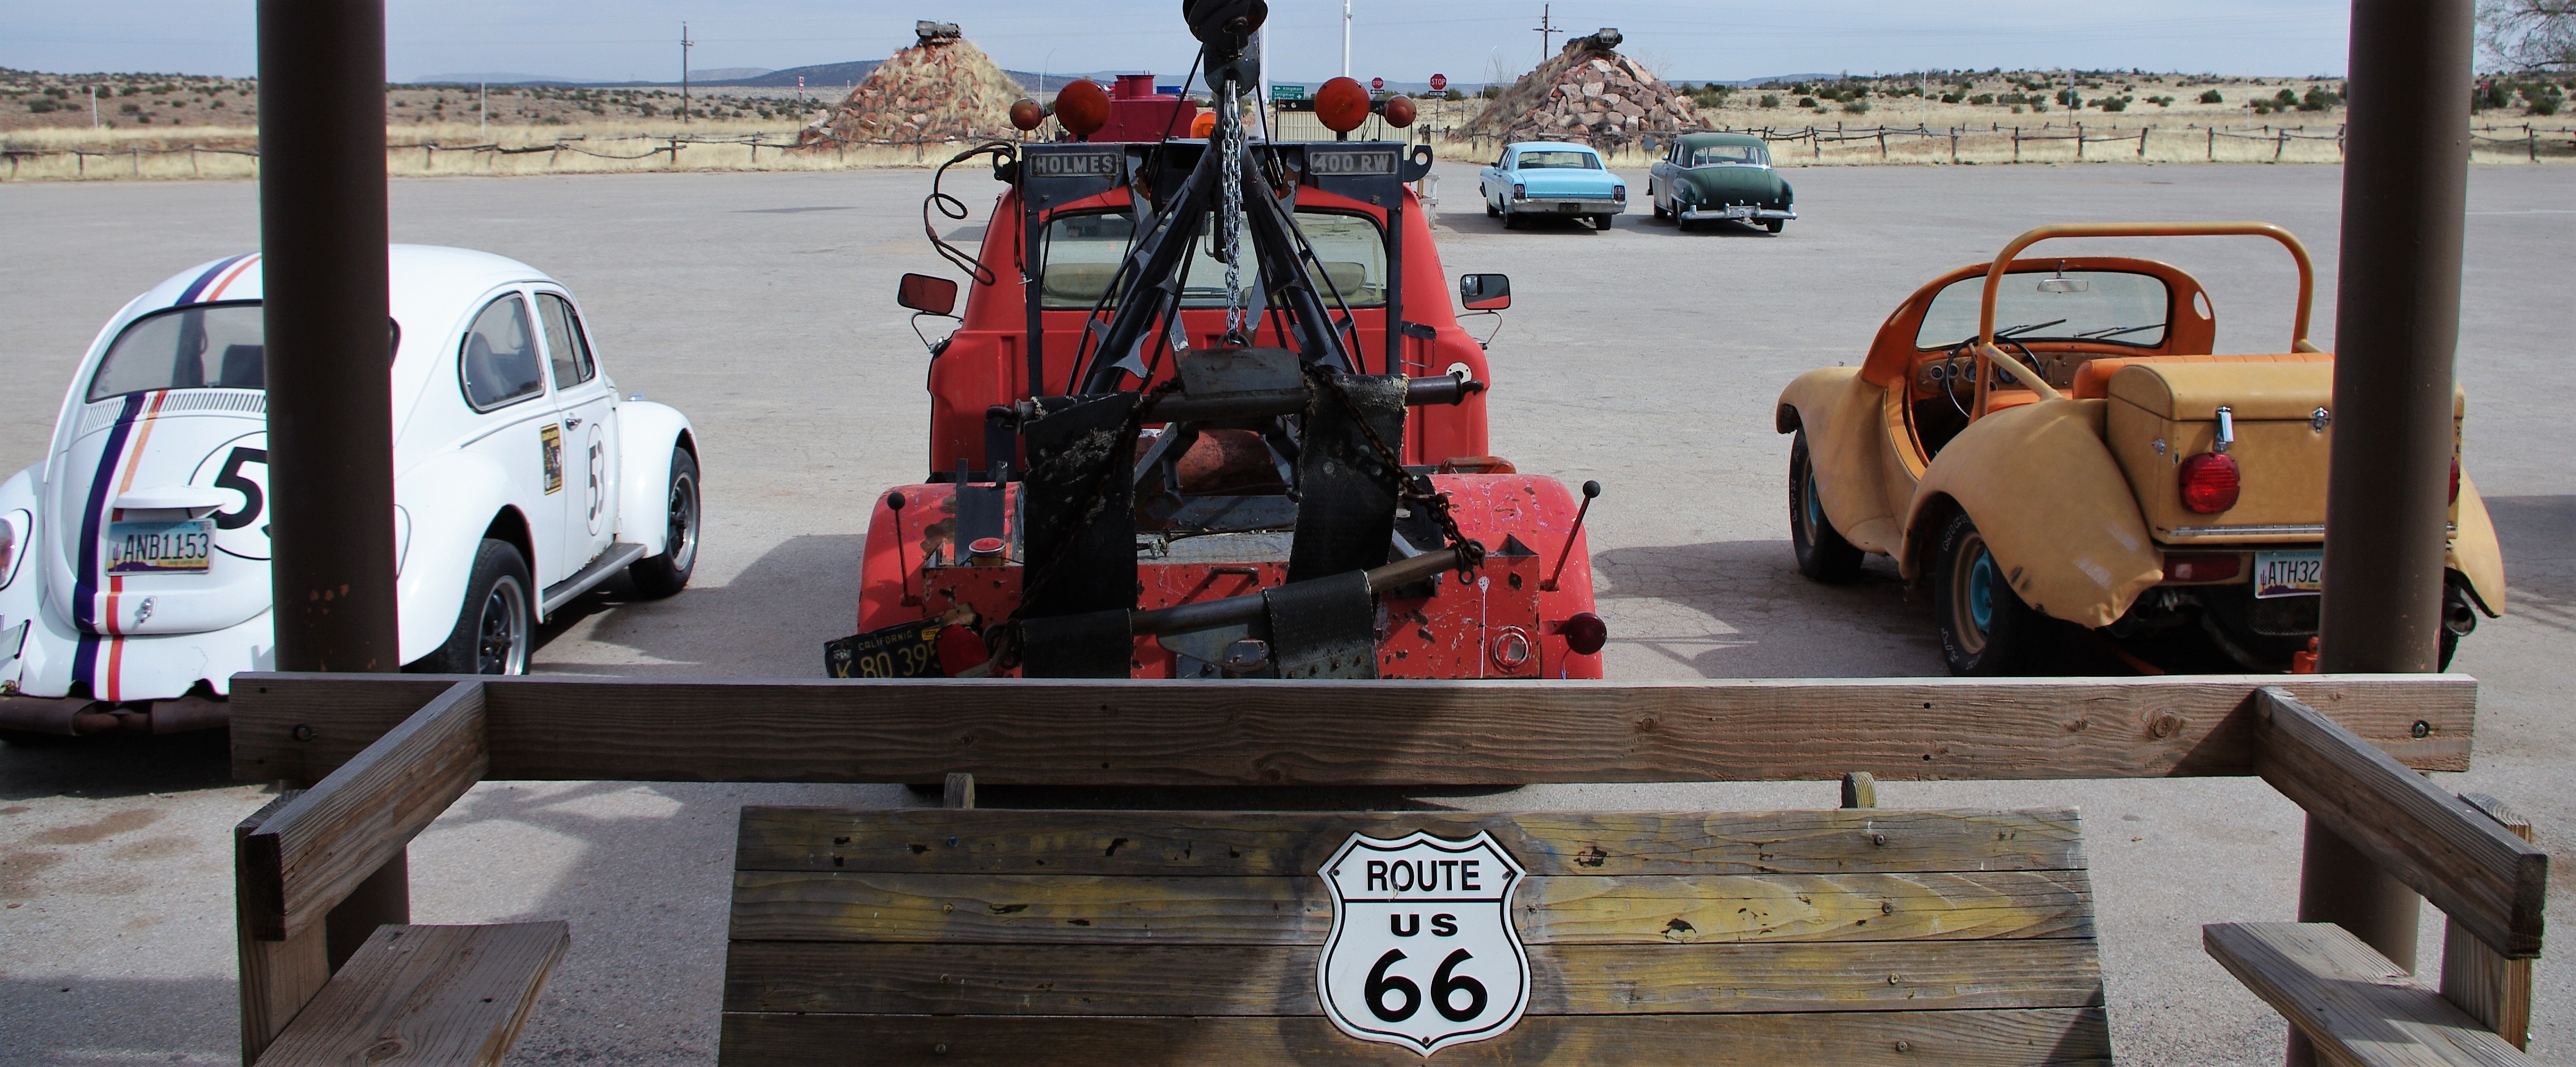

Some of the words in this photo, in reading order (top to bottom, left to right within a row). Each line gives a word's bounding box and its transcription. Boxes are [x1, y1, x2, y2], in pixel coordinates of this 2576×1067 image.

[1036, 155, 1113, 173] HOLMES
[1315, 155, 1354, 172] 400
[1361, 155, 1389, 171] RW
[212, 445, 272, 537] 5
[588, 439, 604, 521] 53
[124, 533, 209, 562] ANB1153
[2268, 560, 2322, 584] ATH32
[858, 630, 913, 651] CALIFORNIA
[835, 660, 851, 678] K
[859, 651, 893, 678] 80
[1367, 859, 1481, 892] ROUTE
[1390, 913, 1459, 937] US
[1364, 947, 1488, 1023] 66
